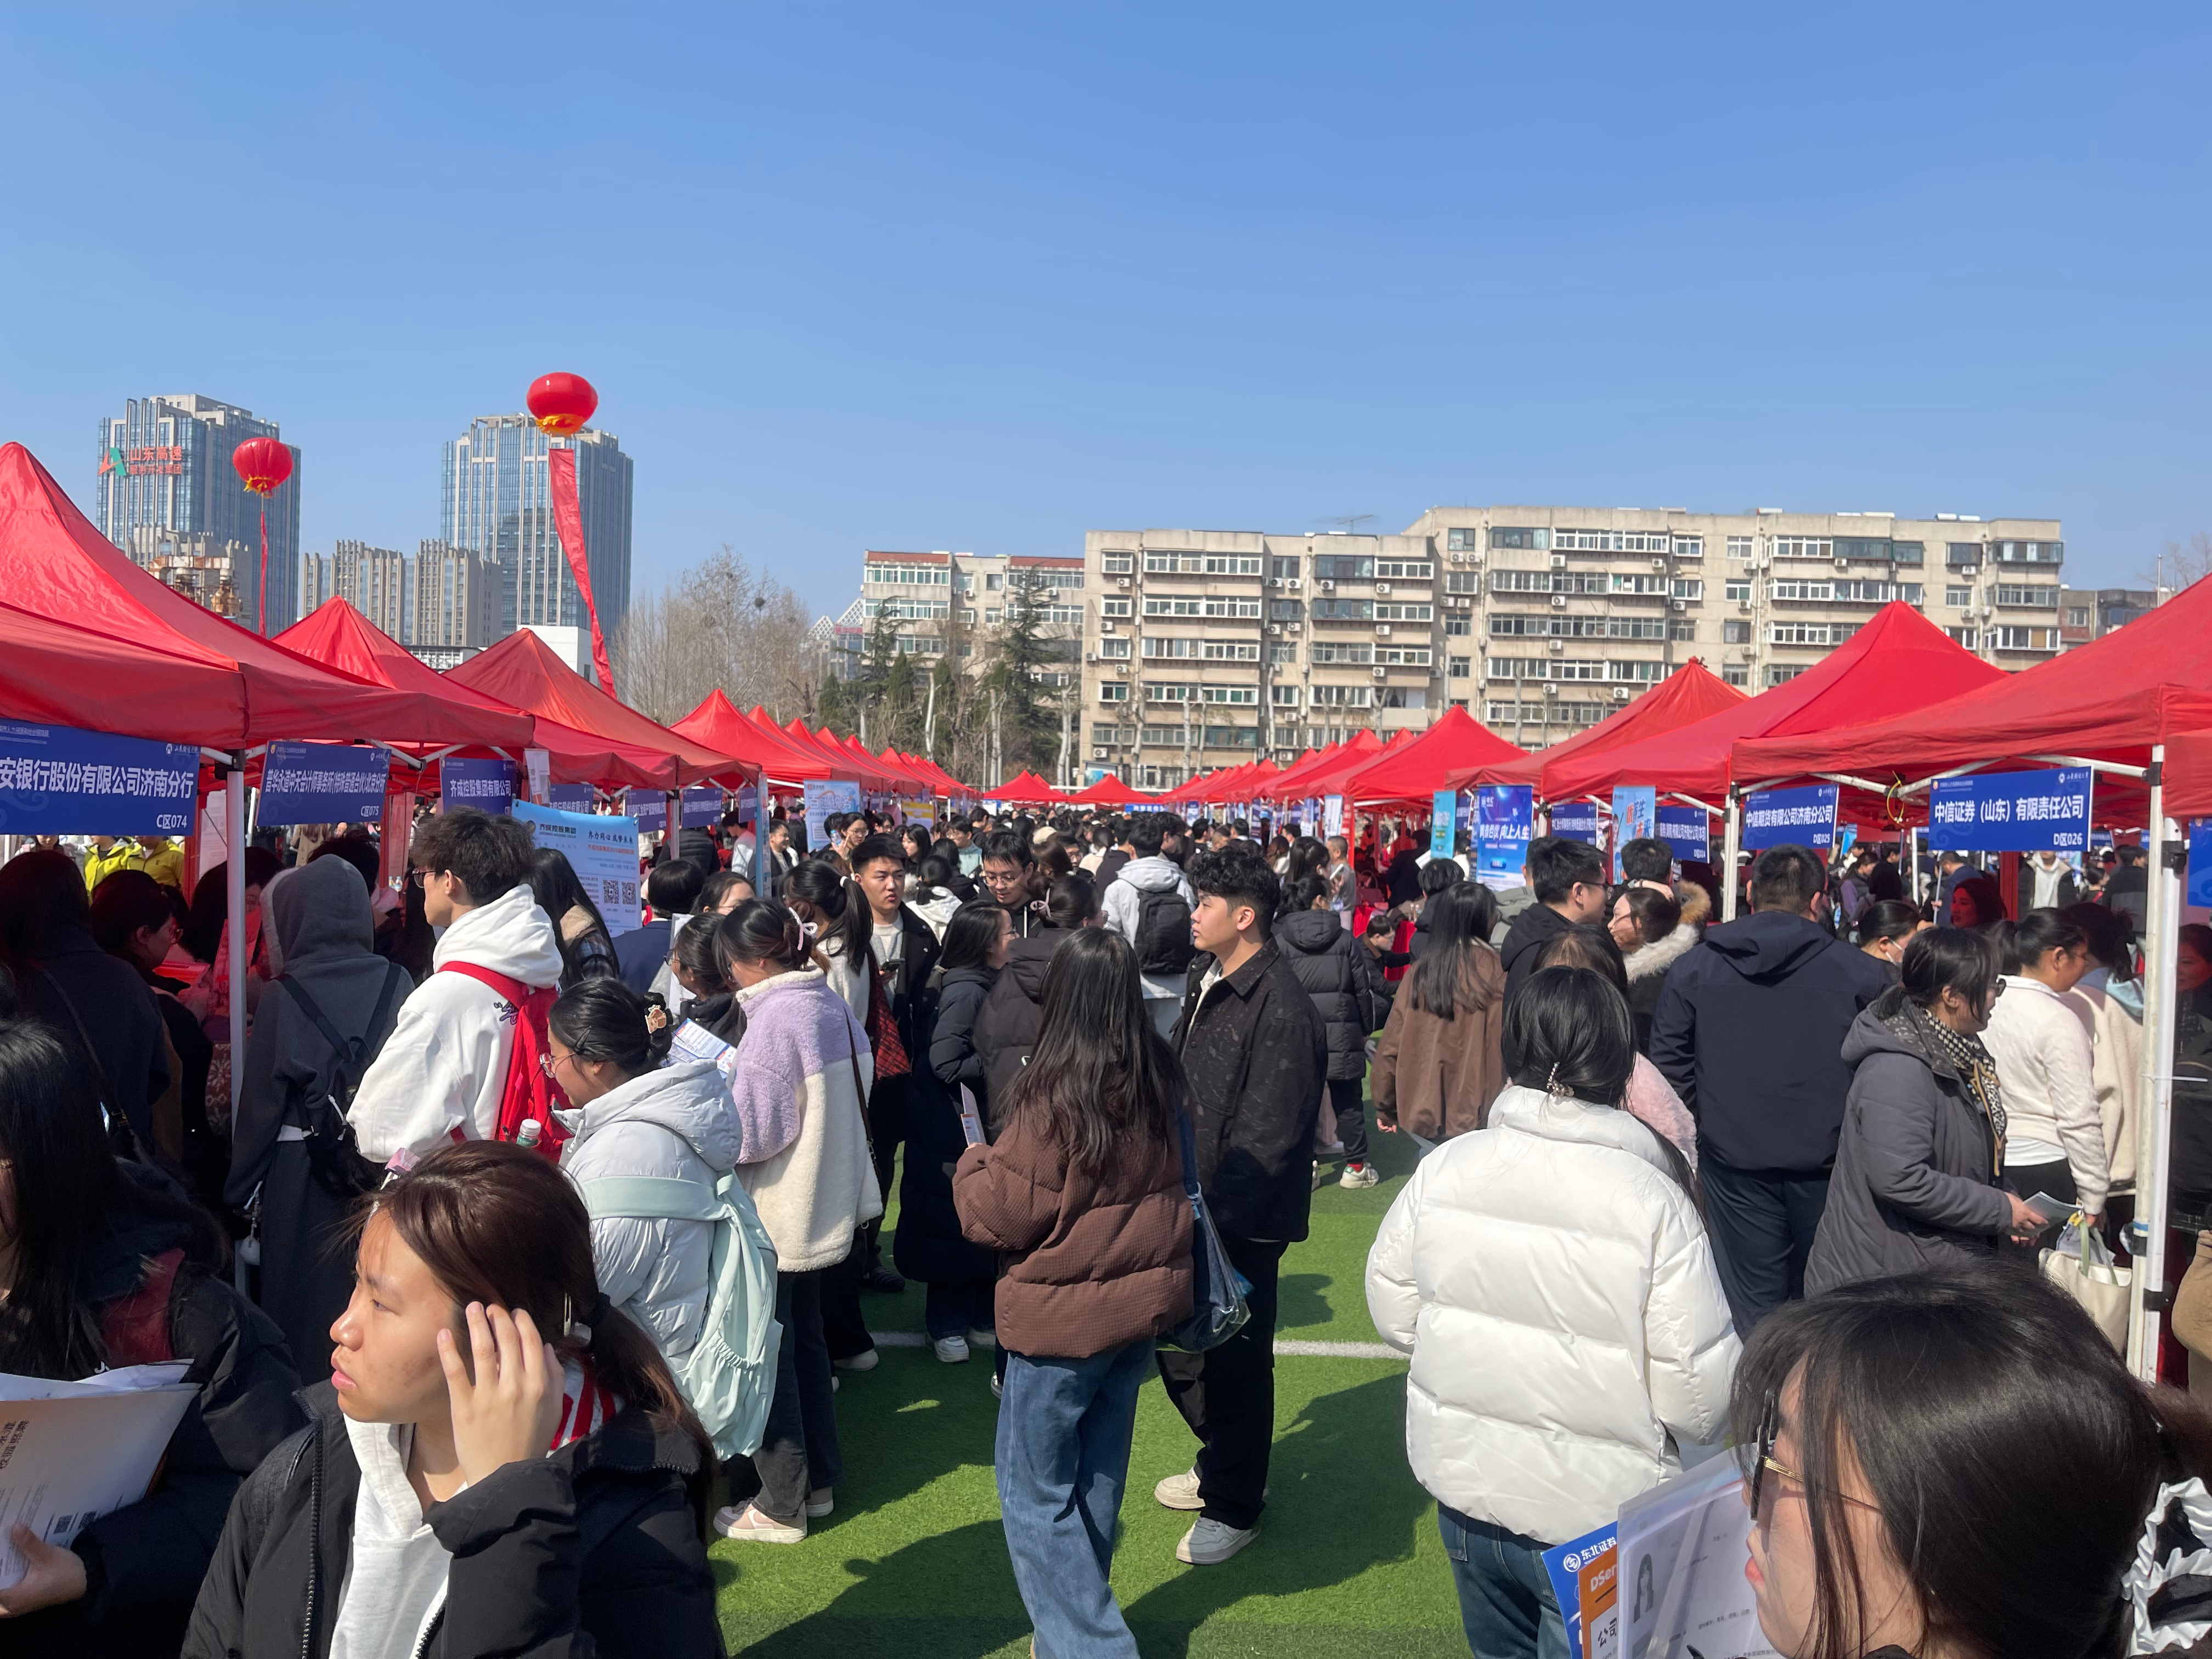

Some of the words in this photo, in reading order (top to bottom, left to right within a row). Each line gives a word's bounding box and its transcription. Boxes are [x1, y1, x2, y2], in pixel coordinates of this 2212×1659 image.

[129, 446, 183, 461] 山东高速
[0, 757, 194, 799] 安银行股份有限公司济南分行
[450, 778, 511, 797] 齐成控股集团有限公司
[360, 805, 380, 817] C区075
[1746, 804, 1833, 828] 中信期货有限公司济南分公司
[156, 815, 187, 830] C区074
[1813, 833, 1830, 844] D区025
[2053, 833, 2083, 847] D区026
[1581, 1537, 1616, 1561] 东北证券
